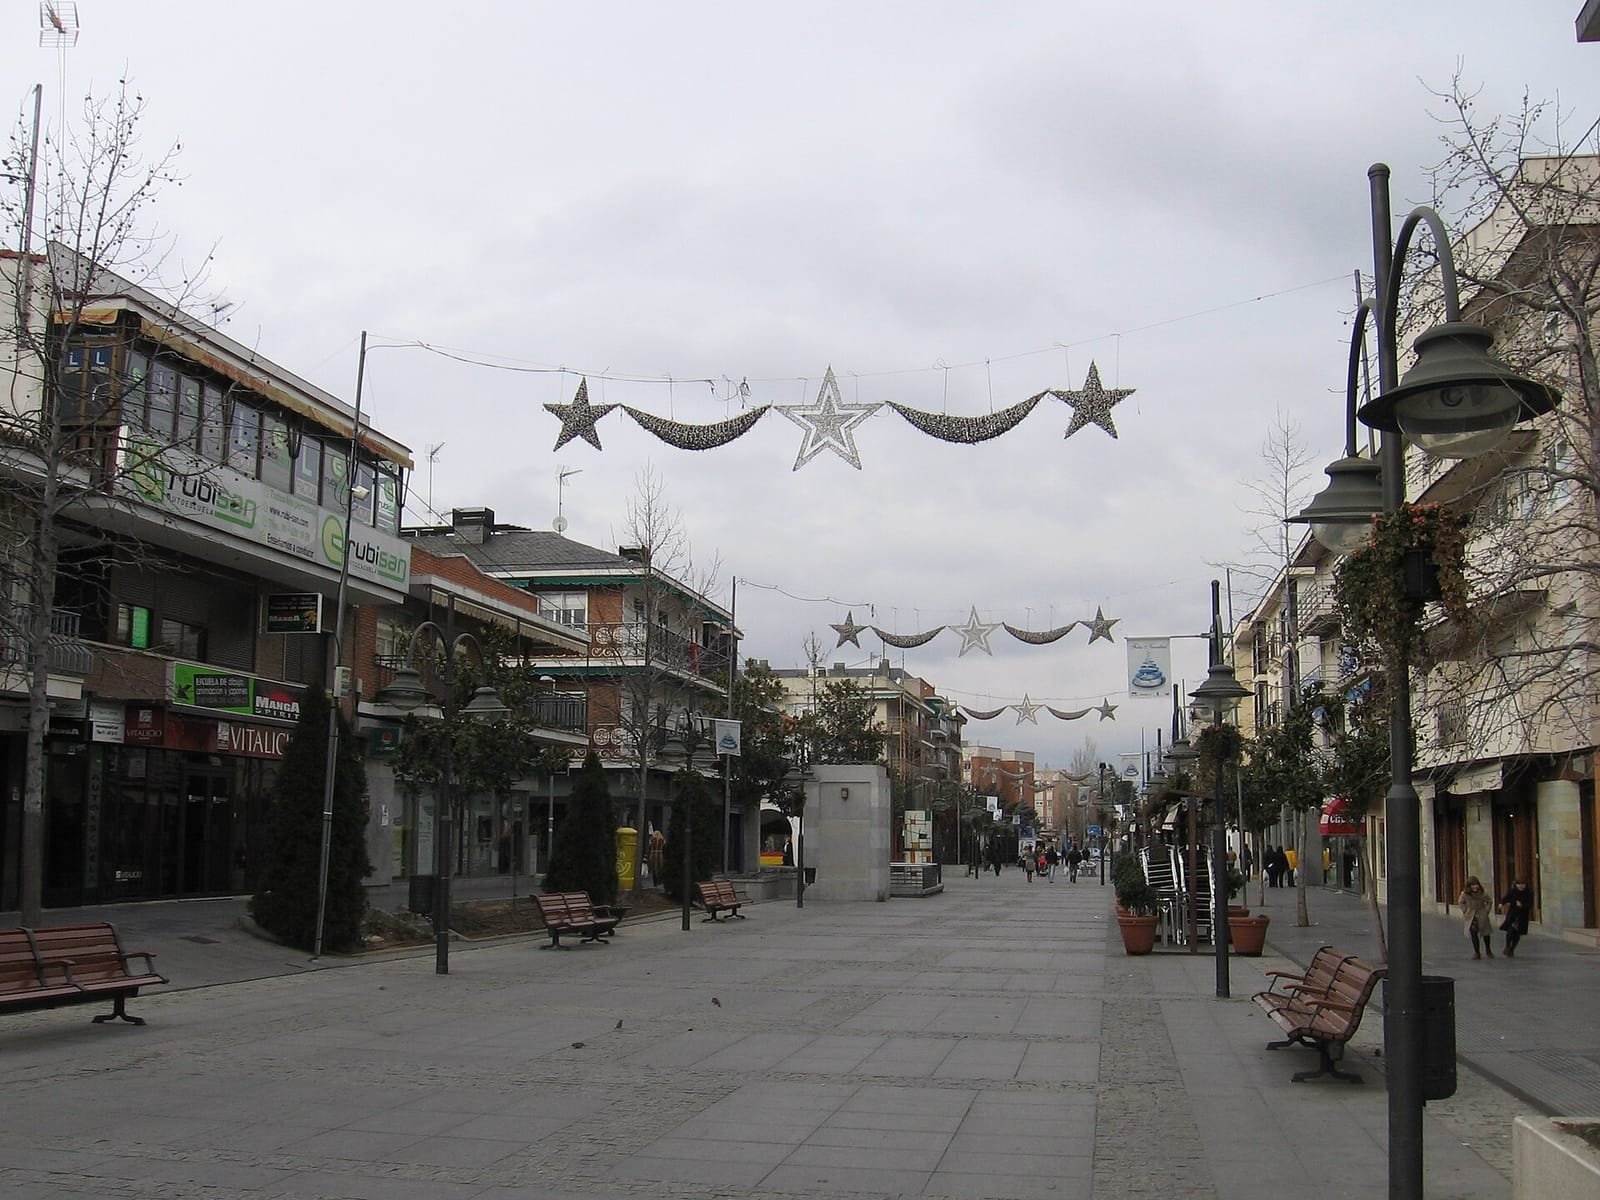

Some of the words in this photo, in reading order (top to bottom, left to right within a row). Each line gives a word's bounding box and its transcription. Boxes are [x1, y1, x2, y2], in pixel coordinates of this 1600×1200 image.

[168, 472, 256, 527] rubisan
[349, 538, 407, 584] rubisan
[255, 695, 300, 714] MANGA
[255, 708, 300, 720] SPIRIT
[126, 729, 162, 738] VITALICIO
